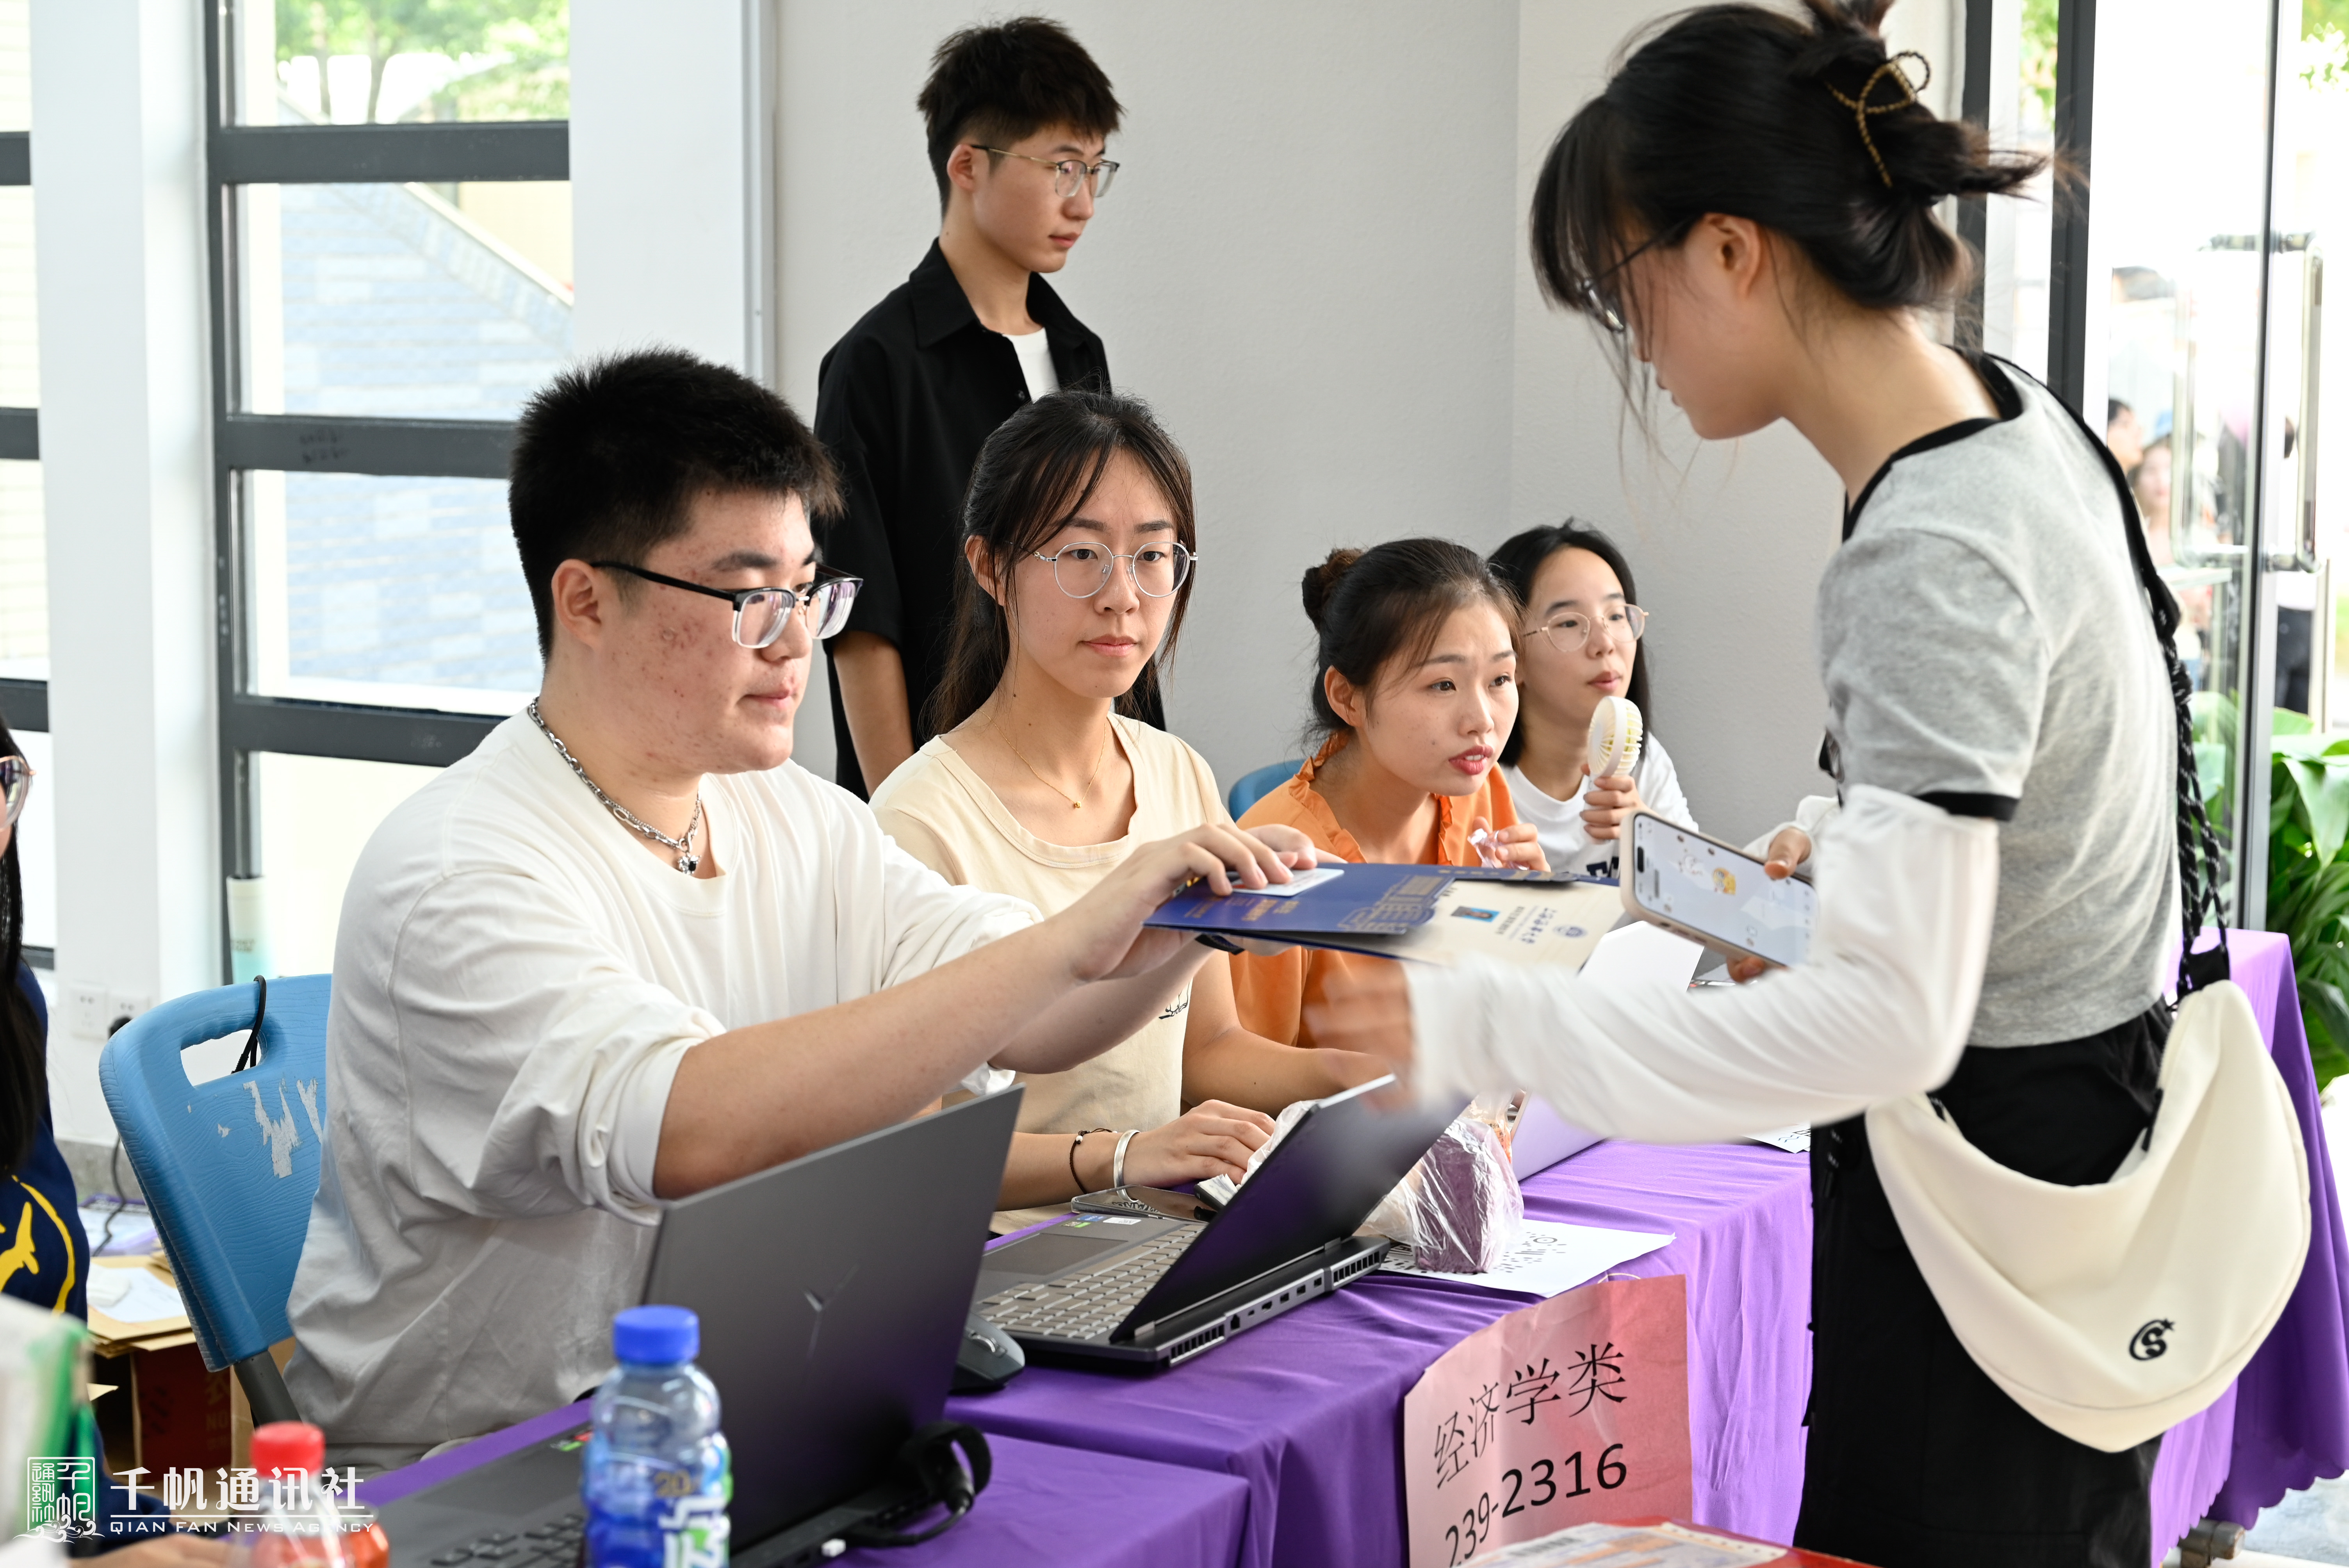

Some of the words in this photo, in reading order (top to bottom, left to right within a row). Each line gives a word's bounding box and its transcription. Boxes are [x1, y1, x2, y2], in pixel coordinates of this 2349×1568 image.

[1434, 1342, 1627, 1489] 经济学类
[1445, 1443, 1627, 1568] 239-2316
